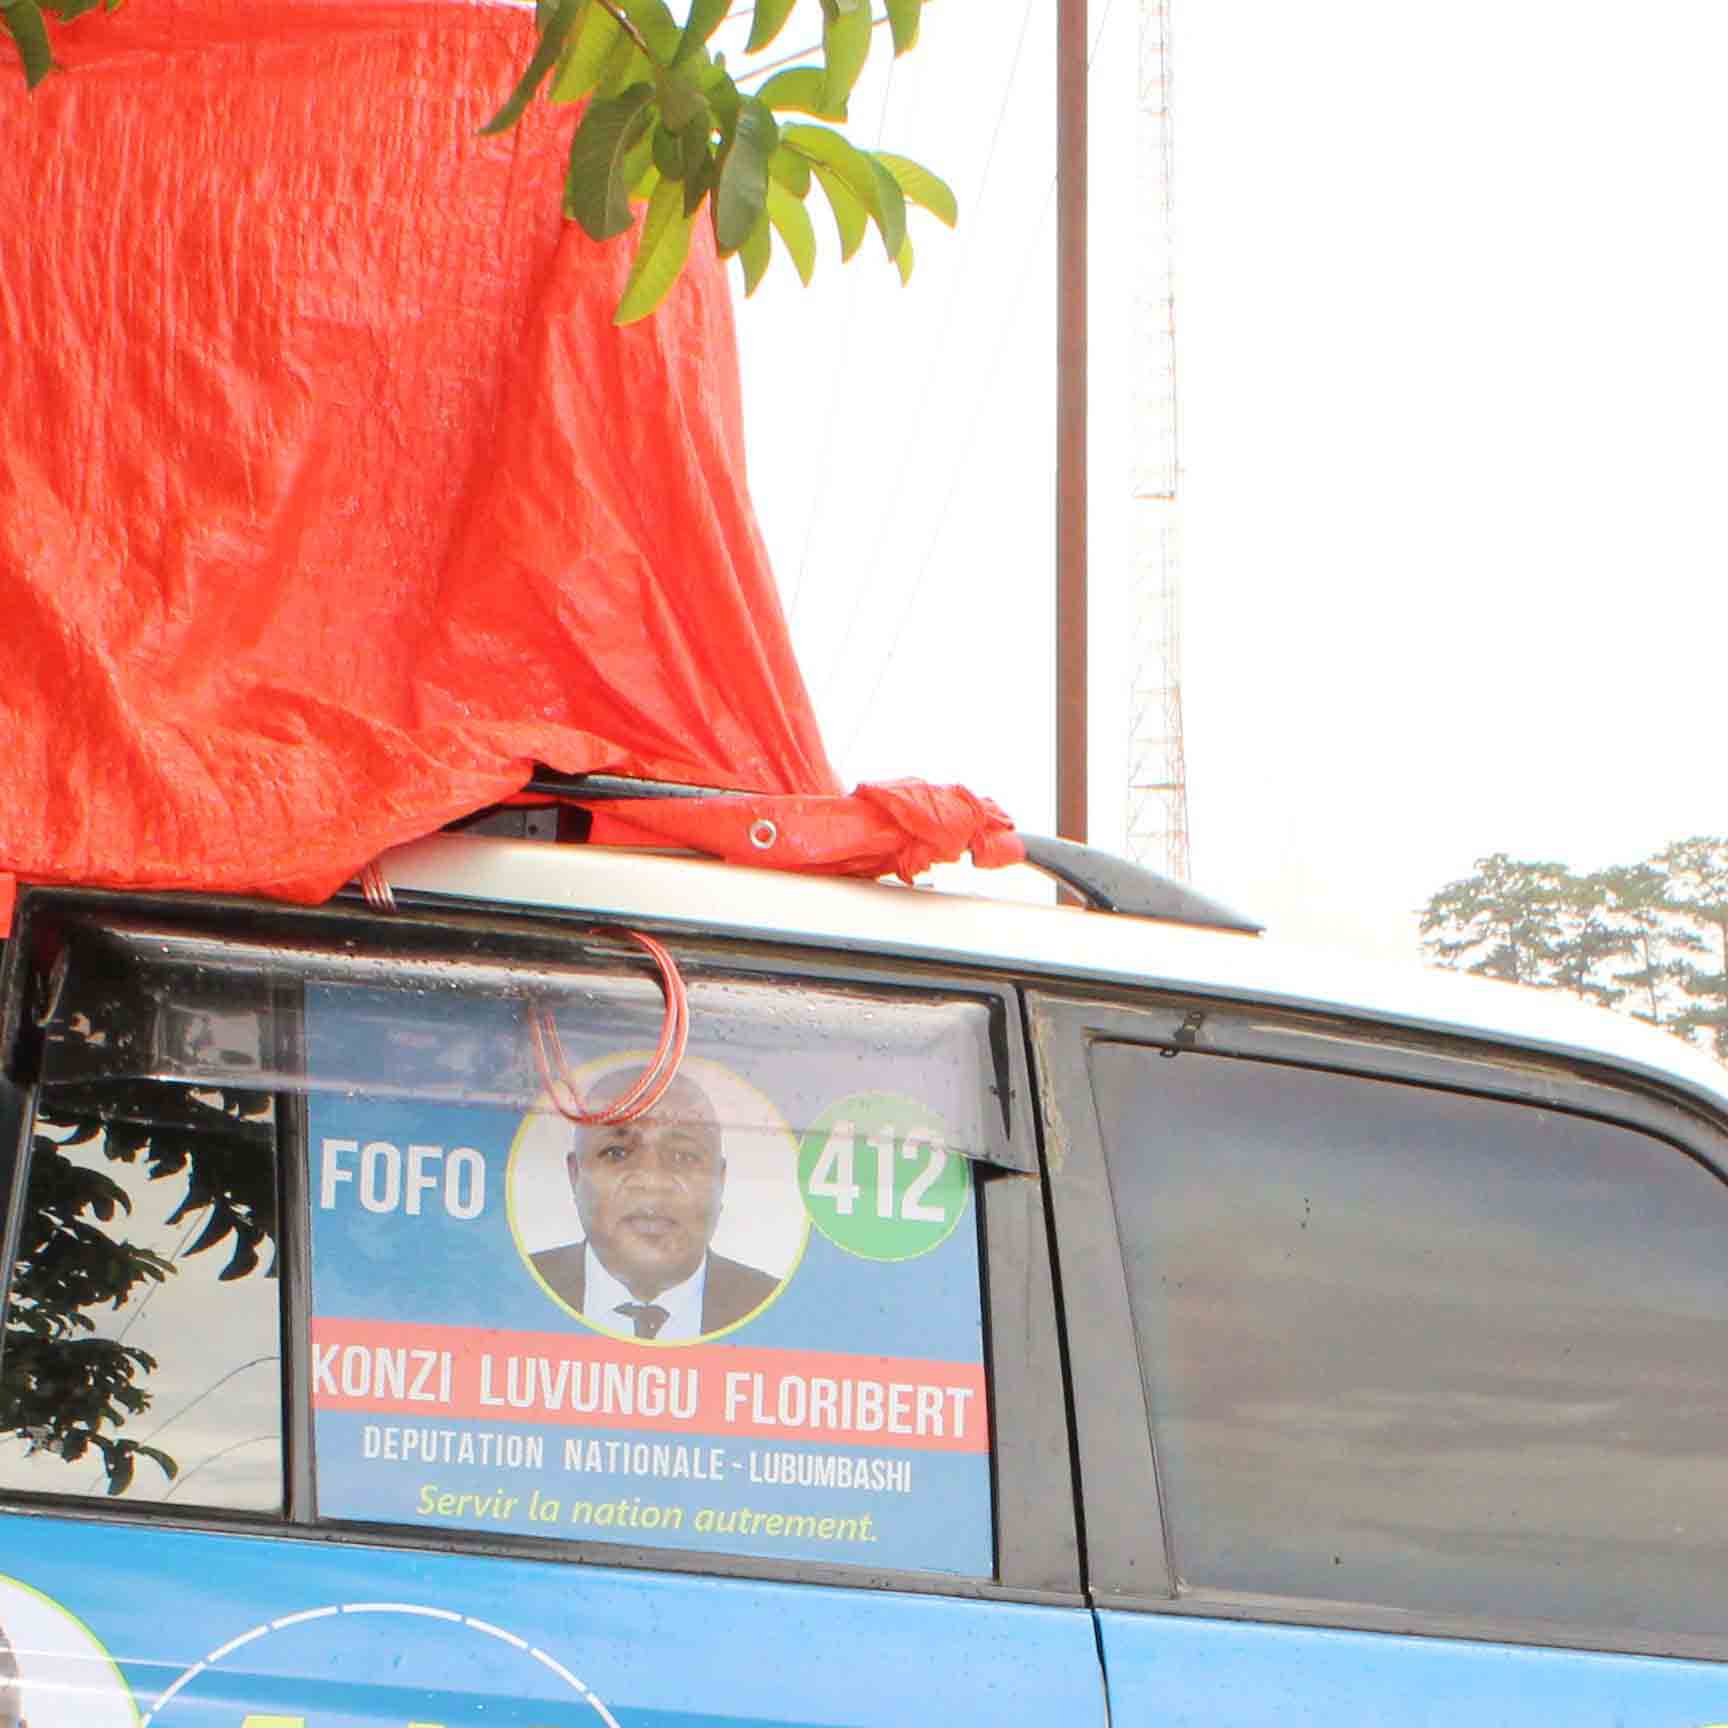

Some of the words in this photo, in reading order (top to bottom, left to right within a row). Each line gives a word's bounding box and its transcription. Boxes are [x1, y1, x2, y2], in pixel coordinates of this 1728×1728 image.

[320, 1138, 486, 1220] FOFO
[809, 1120, 946, 1222] 412
[311, 1344, 452, 1402] KONZI
[479, 1359, 698, 1418] LUVUNGU
[725, 1373, 973, 1437] FLORIBERT
[363, 1425, 543, 1469] DEPUTATION
[563, 1440, 724, 1481] NATIONALE
[749, 1450, 913, 1493] LUBUMBASHI
[417, 1485, 516, 1522] Servir
[529, 1489, 561, 1524] la
[571, 1498, 682, 1531] nation
[694, 1507, 878, 1543] autrement.
